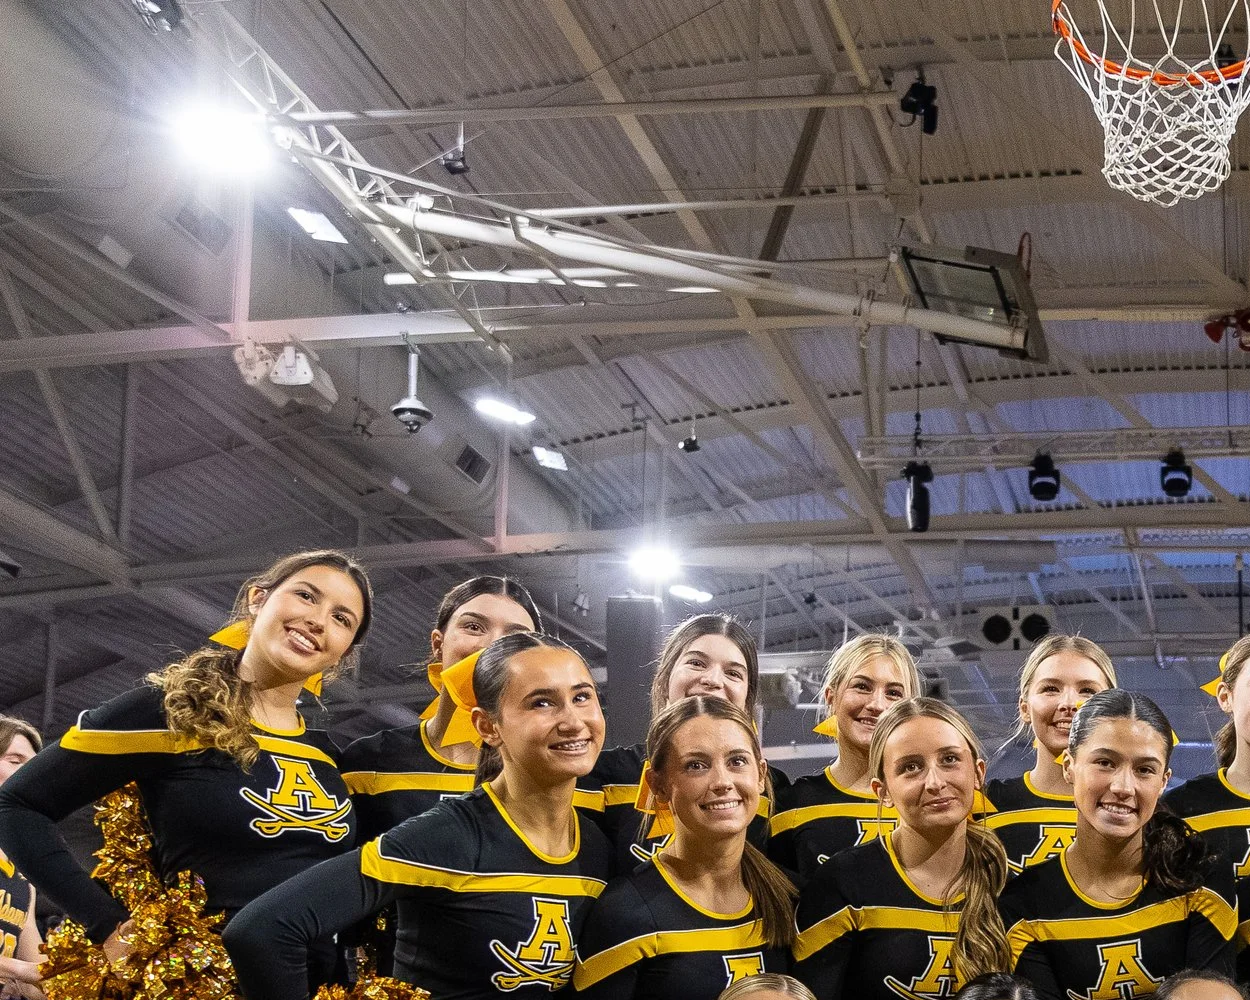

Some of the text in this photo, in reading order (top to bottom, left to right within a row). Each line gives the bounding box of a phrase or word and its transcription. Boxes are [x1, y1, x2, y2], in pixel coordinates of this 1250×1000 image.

[267, 754, 338, 812] A
[514, 897, 578, 964] A
[1087, 939, 1165, 1000] A
